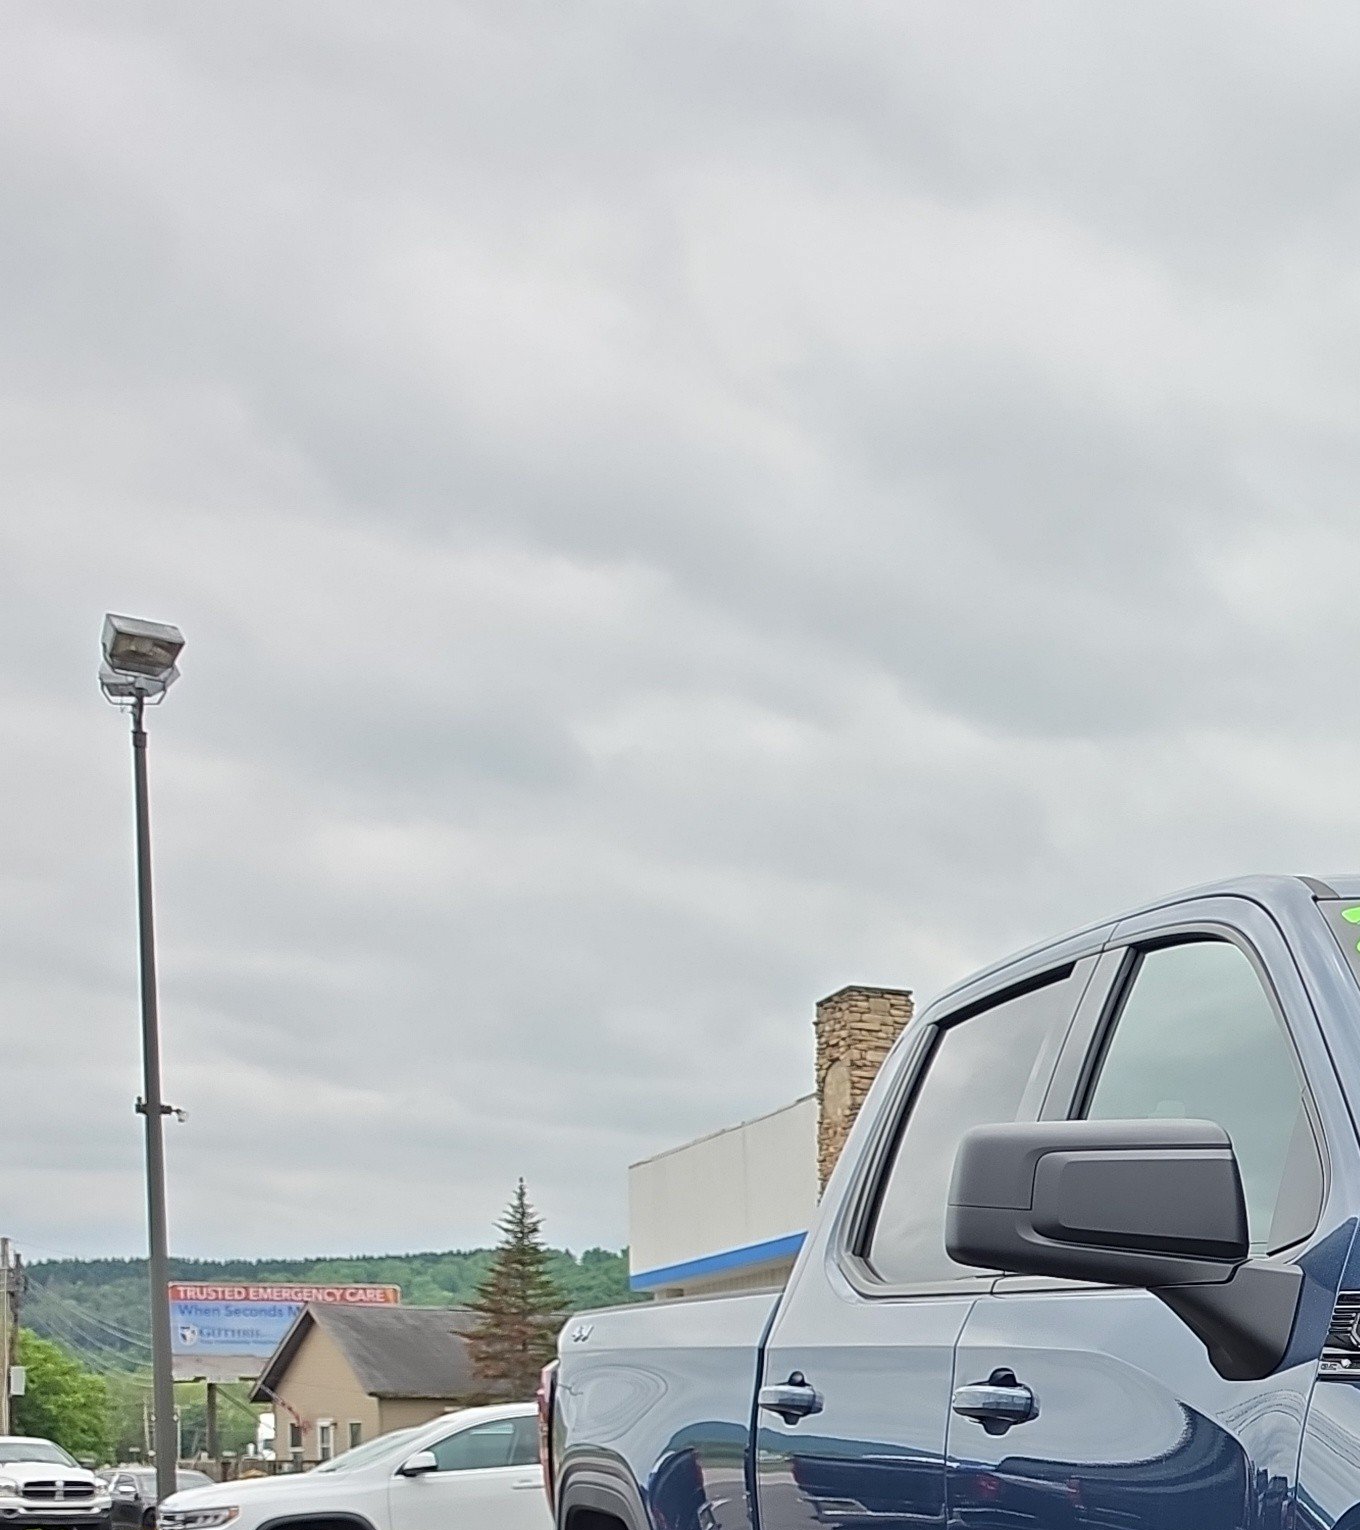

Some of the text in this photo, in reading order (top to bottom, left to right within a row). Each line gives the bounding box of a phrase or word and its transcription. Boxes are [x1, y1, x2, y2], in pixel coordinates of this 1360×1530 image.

[177, 1286, 385, 1301] TRUSTED EMERGENCY CARE
[178, 1304, 220, 1317] When
[224, 1304, 284, 1318] Seconds
